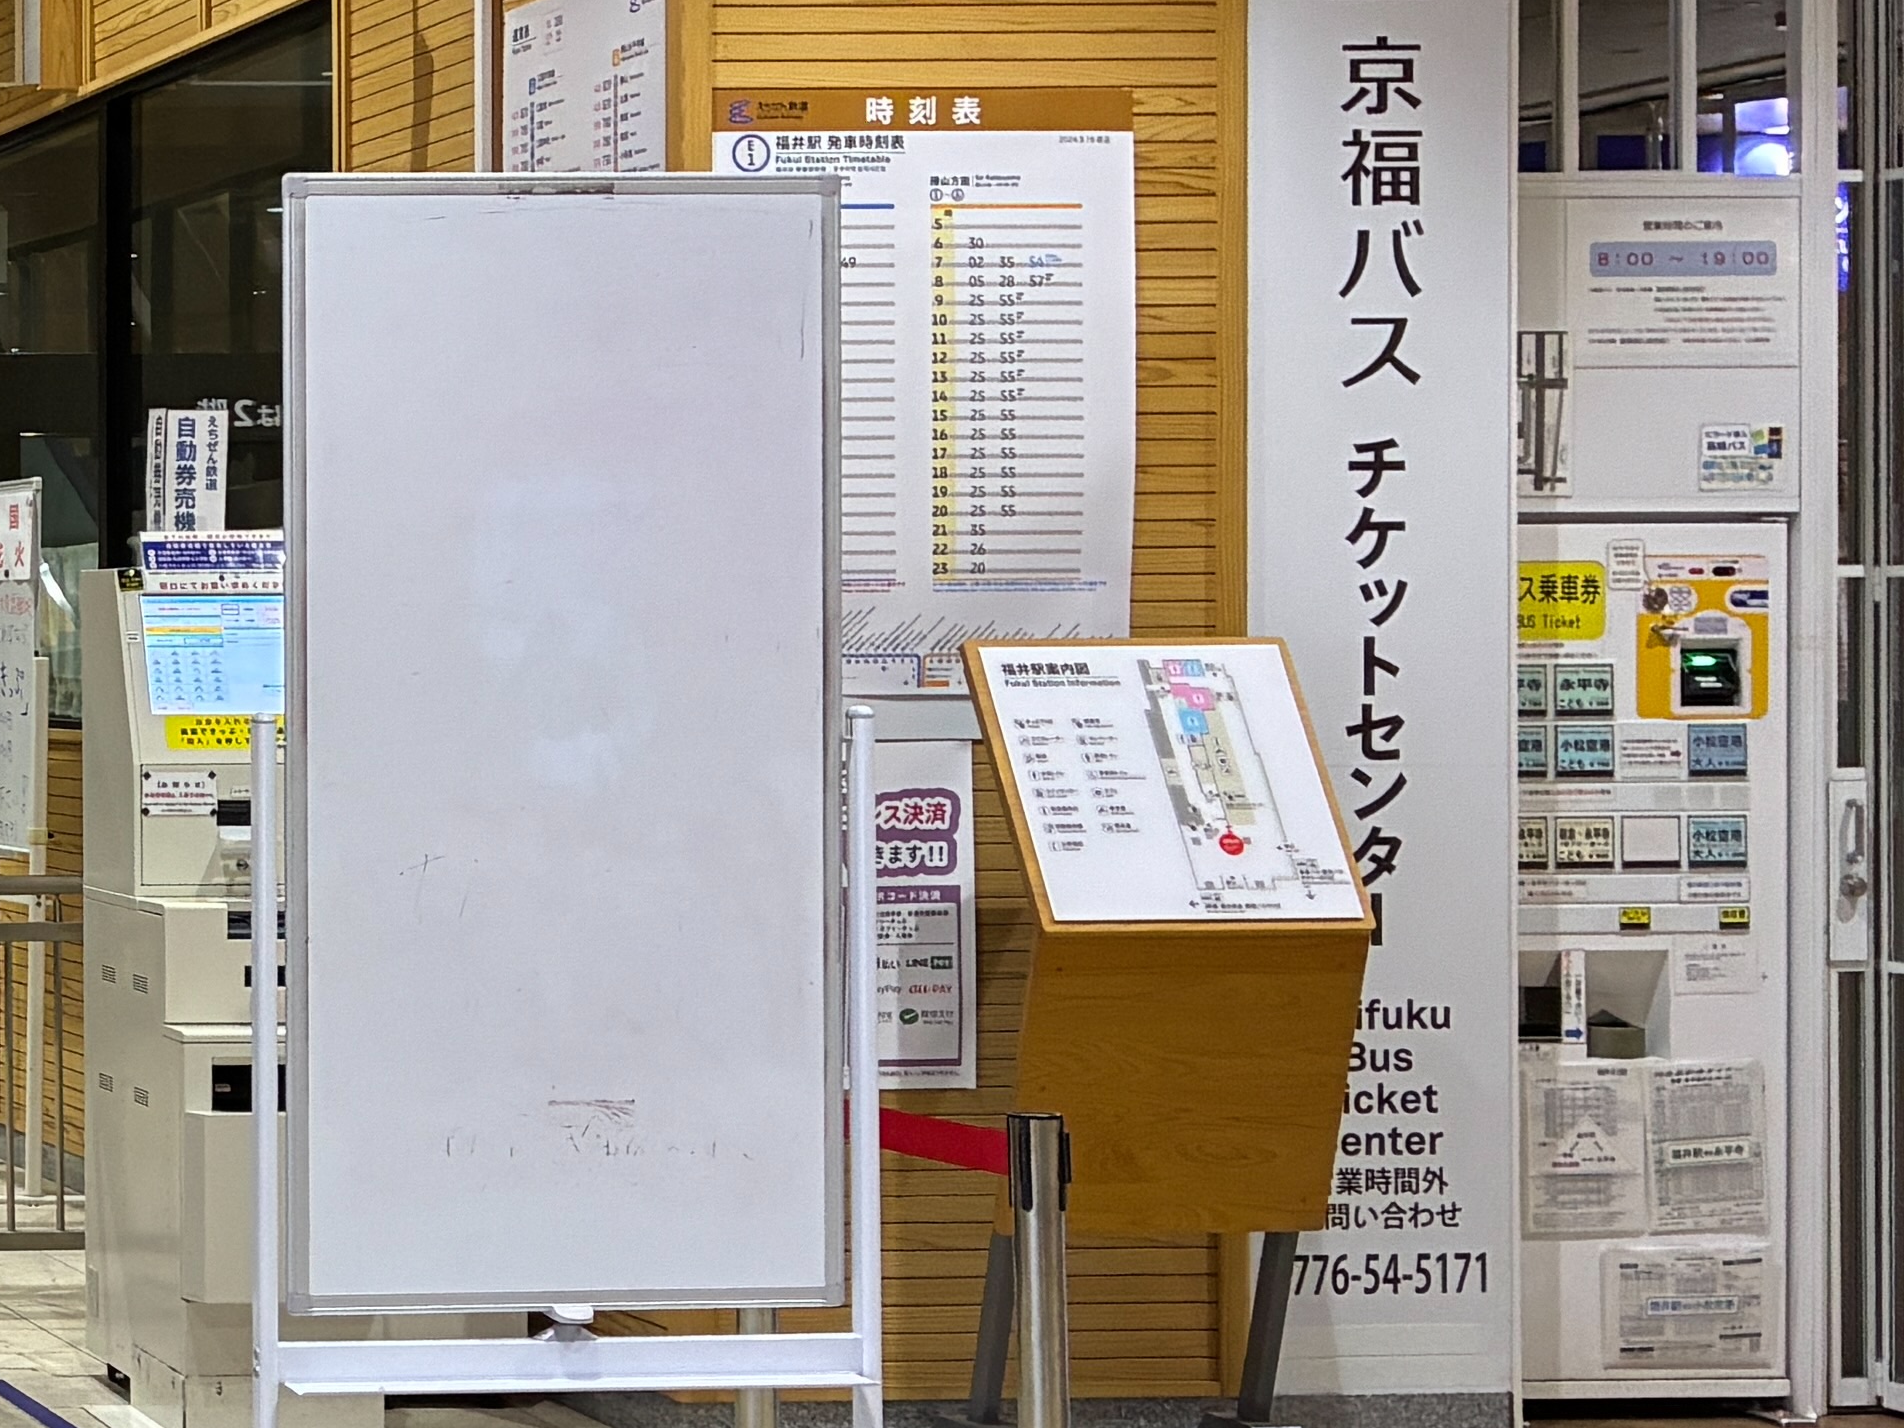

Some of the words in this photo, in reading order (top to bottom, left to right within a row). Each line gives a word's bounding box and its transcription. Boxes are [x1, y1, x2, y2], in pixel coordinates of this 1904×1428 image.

[865, 96, 982, 126] 時刻表
[775, 135, 822, 150] 福井駅
[827, 135, 906, 150] 発車時刻表
[1339, 35, 1425, 389] 京福バス
[204, 415, 220, 492] えちぜん鉄道
[174, 416, 197, 531] 自動券売機
[1518, 573, 1601, 605] ス乗車券
[1542, 614, 1581, 630] Ticket
[1001, 662, 1091, 676] 福井駅案内図
[1344, 436, 1408, 947] チケットセンター
[876, 802, 947, 825] ス決済
[1355, 998, 1452, 1030] ifuku
[1347, 1041, 1414, 1073] Bus
[1343, 1082, 1440, 1115] icket
[1341, 1126, 1444, 1157] enter
[1335, 1166, 1450, 1196] 業時間外
[1324, 1201, 1463, 1231] 問い合わせ
[1293, 1251, 1489, 1296] 776-54-5171
